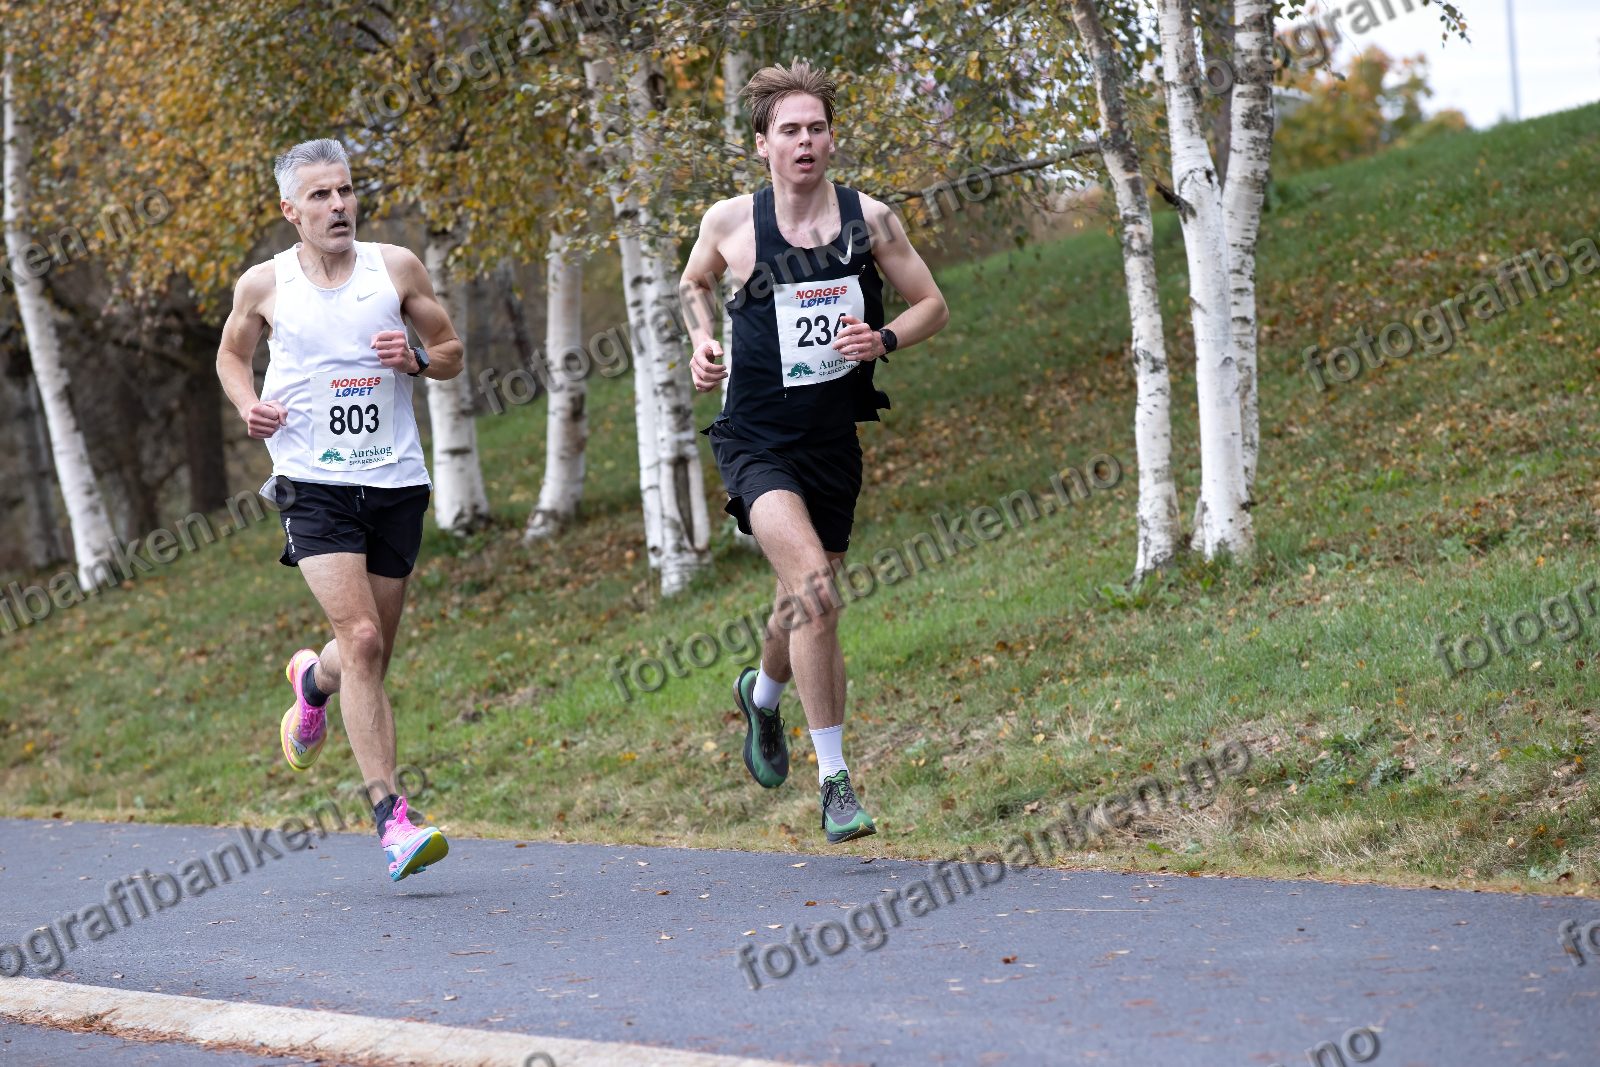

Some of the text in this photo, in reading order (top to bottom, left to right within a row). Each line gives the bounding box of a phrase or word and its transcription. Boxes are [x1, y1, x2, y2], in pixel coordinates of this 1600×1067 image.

[796, 286, 847, 300] NORGES
[801, 296, 840, 308] LØPET
[330, 377, 382, 388] NORGES
[335, 387, 373, 398] LØPET
[329, 404, 380, 435] 803
[349, 445, 393, 458] Aurskog
